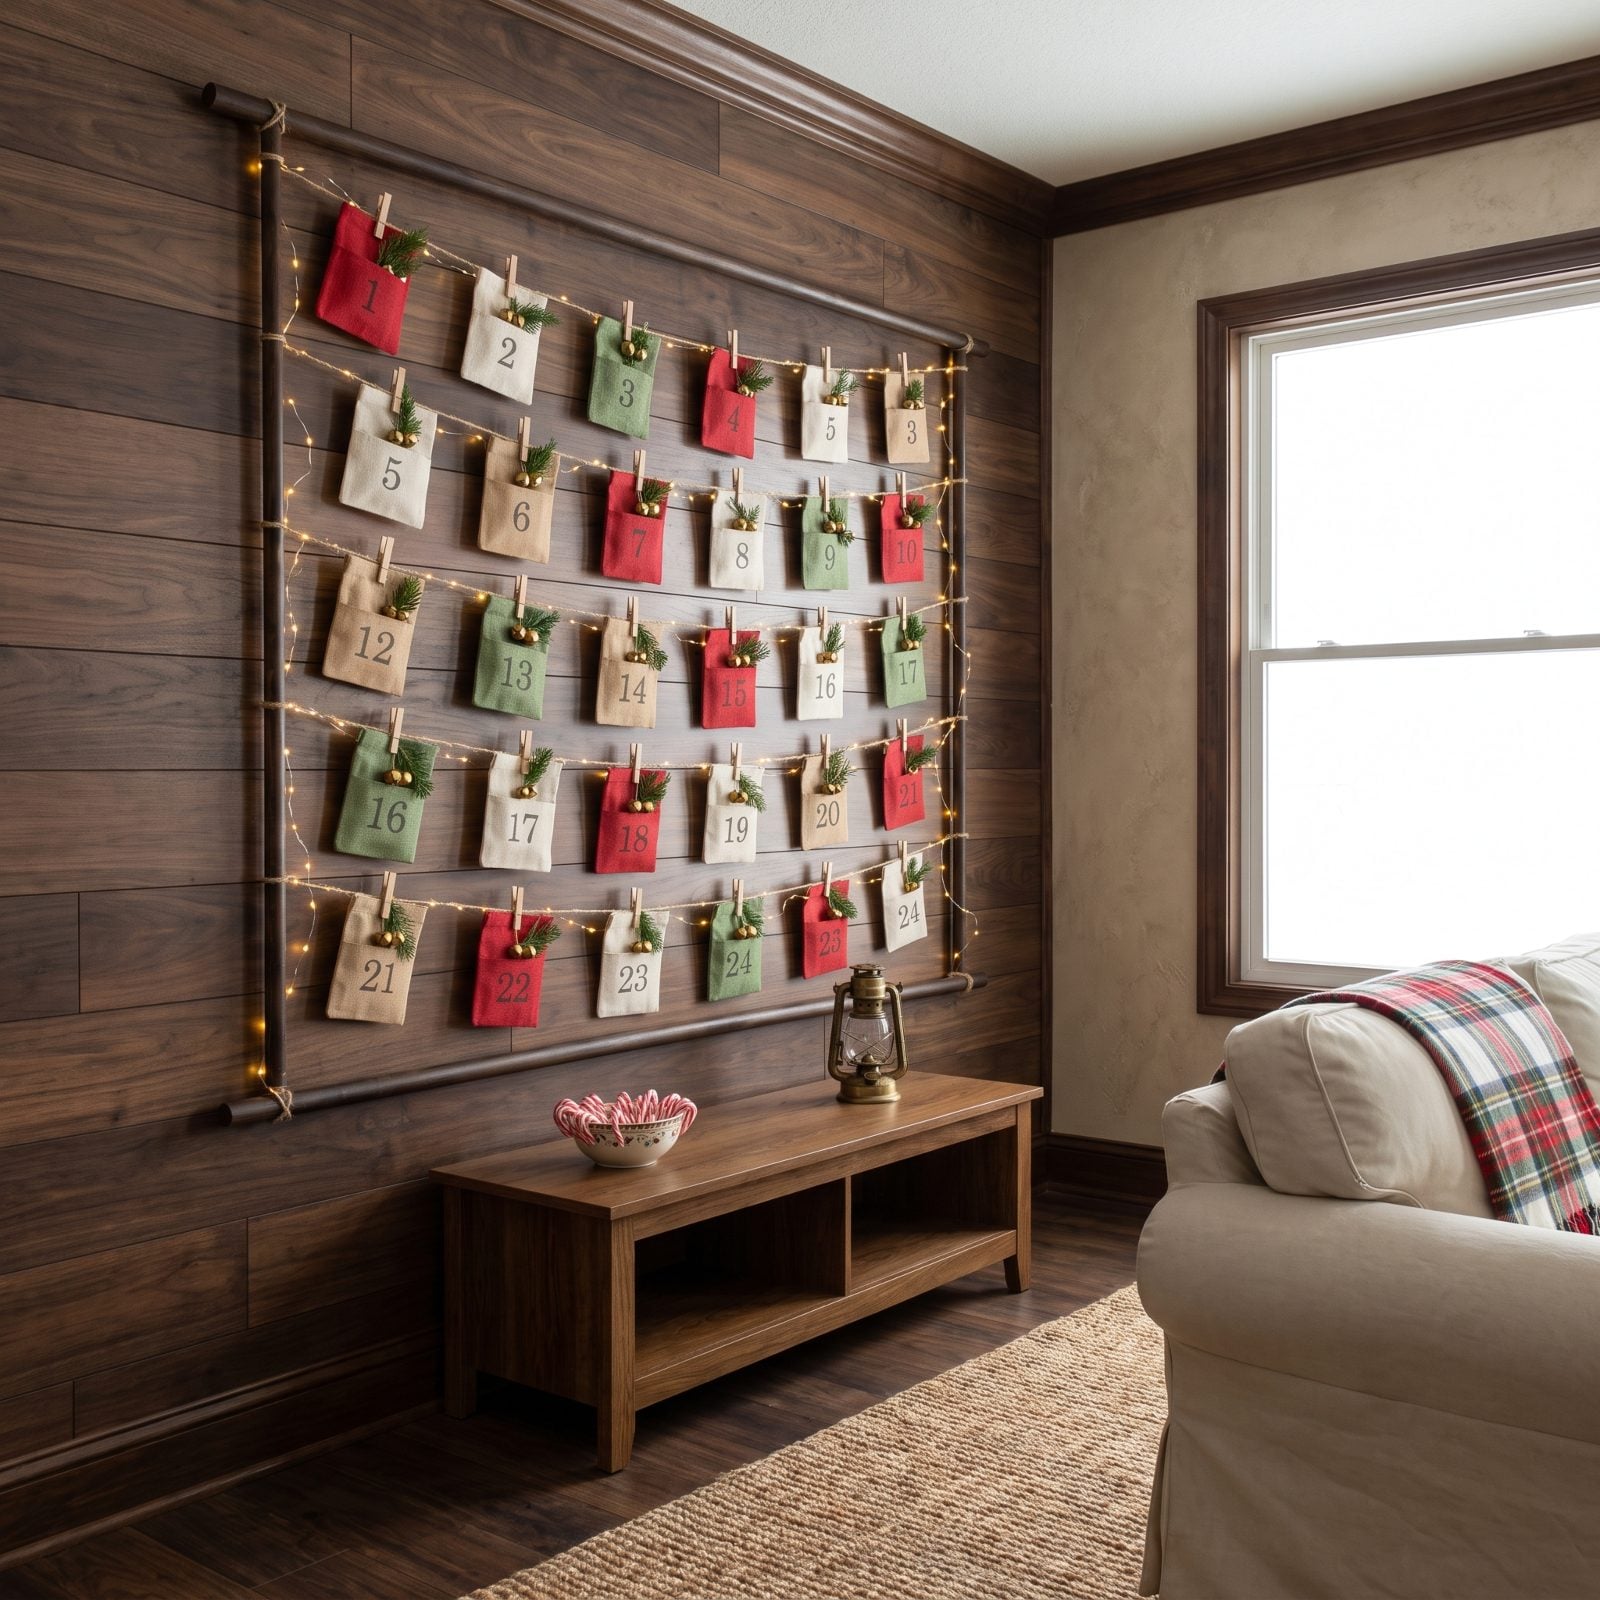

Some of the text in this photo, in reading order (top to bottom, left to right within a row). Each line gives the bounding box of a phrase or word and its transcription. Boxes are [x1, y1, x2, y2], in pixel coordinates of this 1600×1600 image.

[362, 280, 378, 314] 1
[497, 337, 516, 369] 2
[619, 379, 634, 407] 3
[728, 405, 740, 432] 4
[826, 417, 836, 440] 5
[907, 420, 917, 445] 3
[382, 457, 402, 490] 5
[513, 502, 530, 532] 6
[632, 529, 647, 558] 7
[736, 543, 749, 569] 8
[825, 545, 835, 570] 9
[897, 539, 917, 564] 10
[354, 626, 394, 665] 12
[501, 657, 532, 691] 13
[816, 673, 835, 699] 16
[898, 659, 917, 686] 17
[619, 674, 646, 704] 14
[722, 678, 746, 707] 15
[900, 782, 918, 808] 21
[368, 797, 407, 833] 16
[508, 813, 538, 843] 17
[816, 801, 839, 828] 20
[619, 825, 648, 852] 18
[725, 817, 748, 843] 19
[899, 900, 920, 929] 24
[359, 959, 394, 993] 21
[726, 949, 752, 978] 24
[496, 972, 530, 1003] 22
[618, 964, 647, 993] 23
